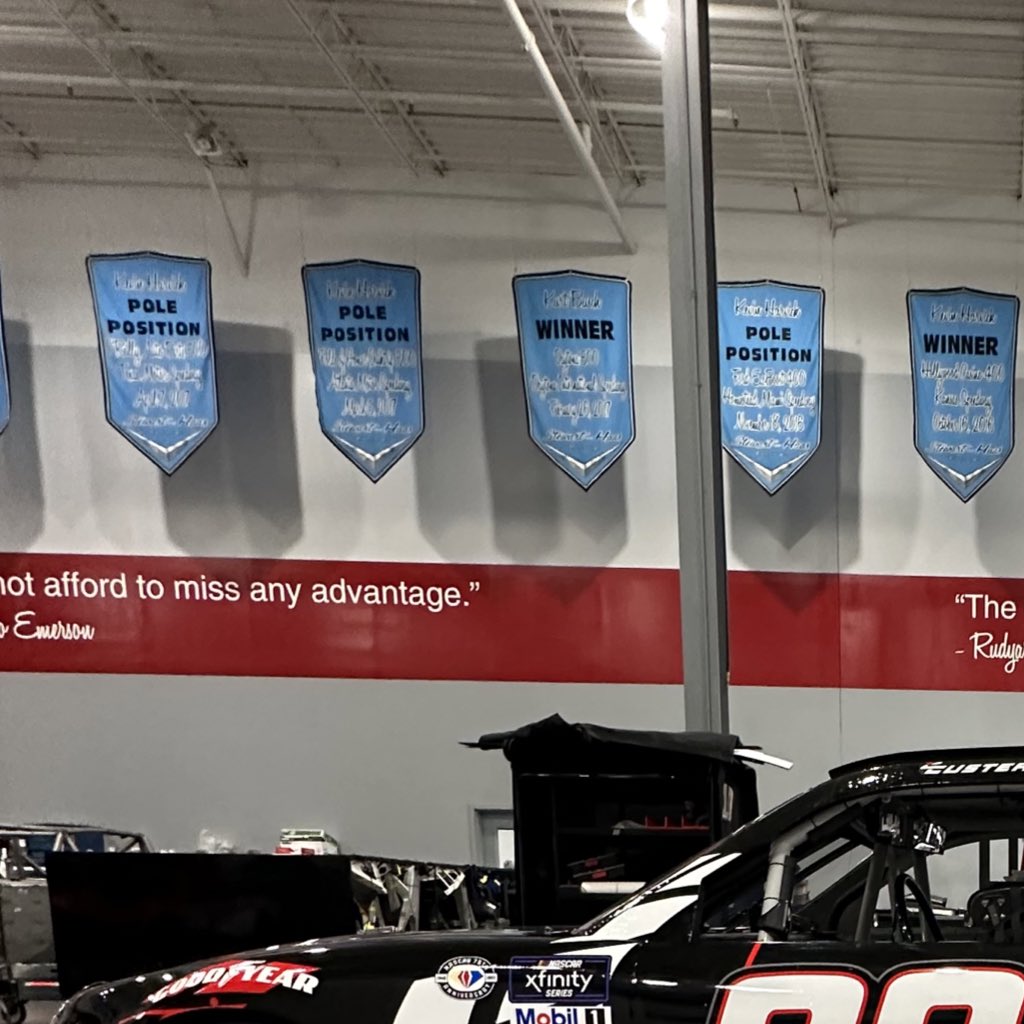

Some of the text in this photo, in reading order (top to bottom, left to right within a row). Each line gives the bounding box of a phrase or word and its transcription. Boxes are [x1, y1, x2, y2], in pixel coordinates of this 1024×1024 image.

[127, 299, 177, 314] POLE
[339, 305, 387, 321] POLE
[107, 319, 200, 336] POSITION
[321, 327, 409, 342] POSITION
[535, 319, 615, 341] WINNER
[746, 326, 791, 341] POLE
[923, 334, 999, 356] WINNER
[726, 347, 812, 363] POSITION
[44, 571, 128, 599] afford
[135, 574, 164, 599] to
[173, 574, 240, 601] miss
[250, 581, 302, 609] any
[13, 610, 95, 640] Emerson
[548, 959, 583, 969] NASCAR
[147, 959, 319, 1004] GOODYEAR
[525, 970, 593, 993] xfinity
[545, 989, 573, 998] SERIES
